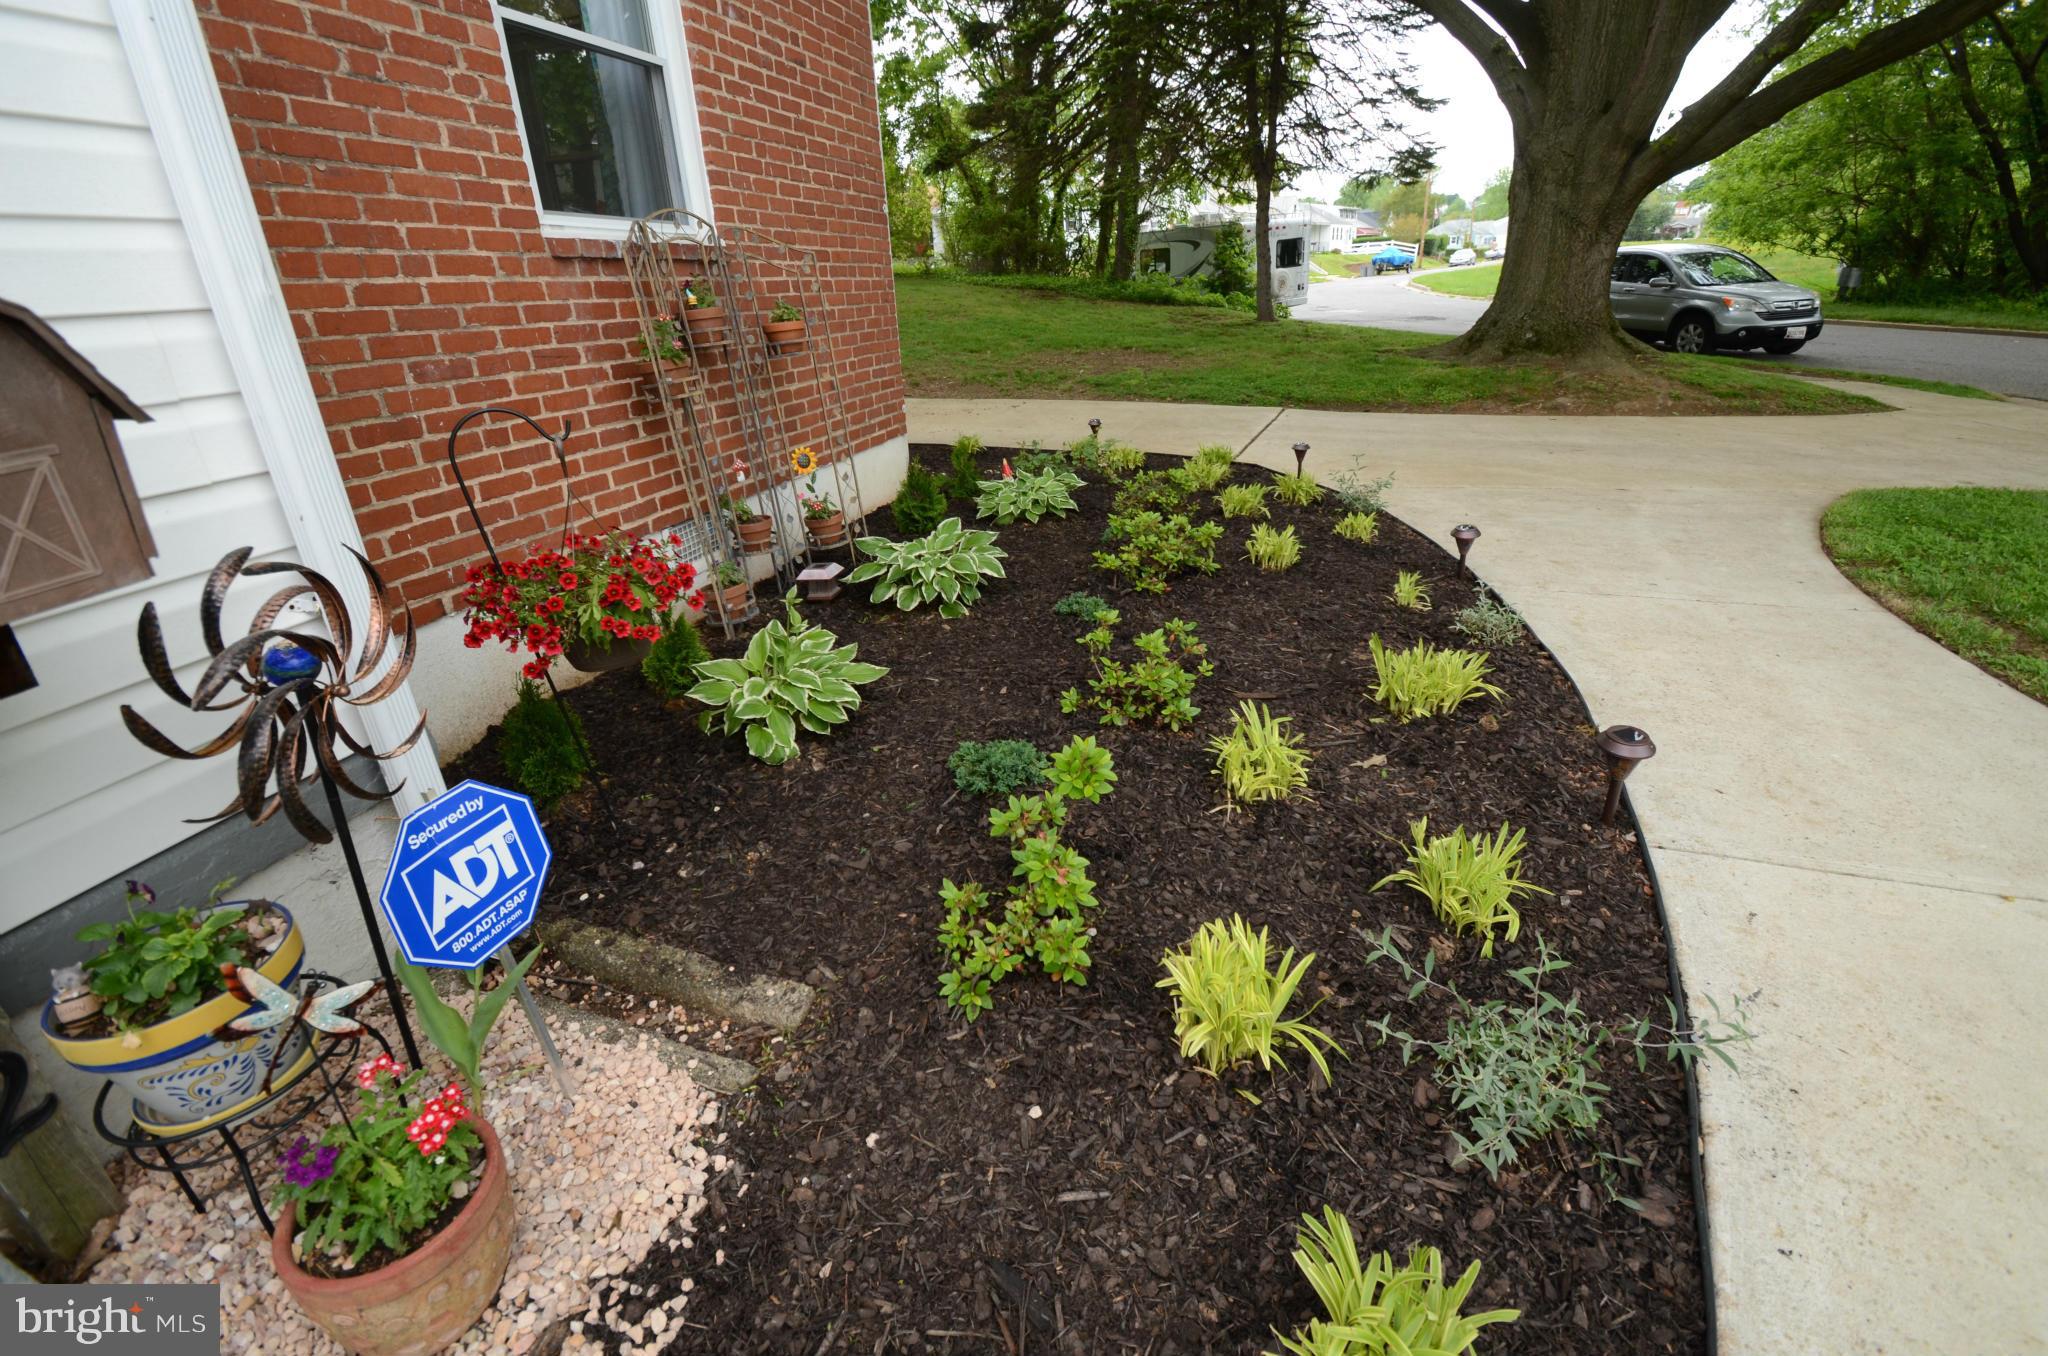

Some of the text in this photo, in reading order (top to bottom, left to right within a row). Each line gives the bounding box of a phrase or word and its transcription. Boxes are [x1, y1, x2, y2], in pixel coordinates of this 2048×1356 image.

[407, 795, 484, 850] Secured by
[432, 819, 519, 936] ADT
[451, 889, 528, 954] 800.ADT.ASAP
[469, 909, 523, 953] www.ADT.com
